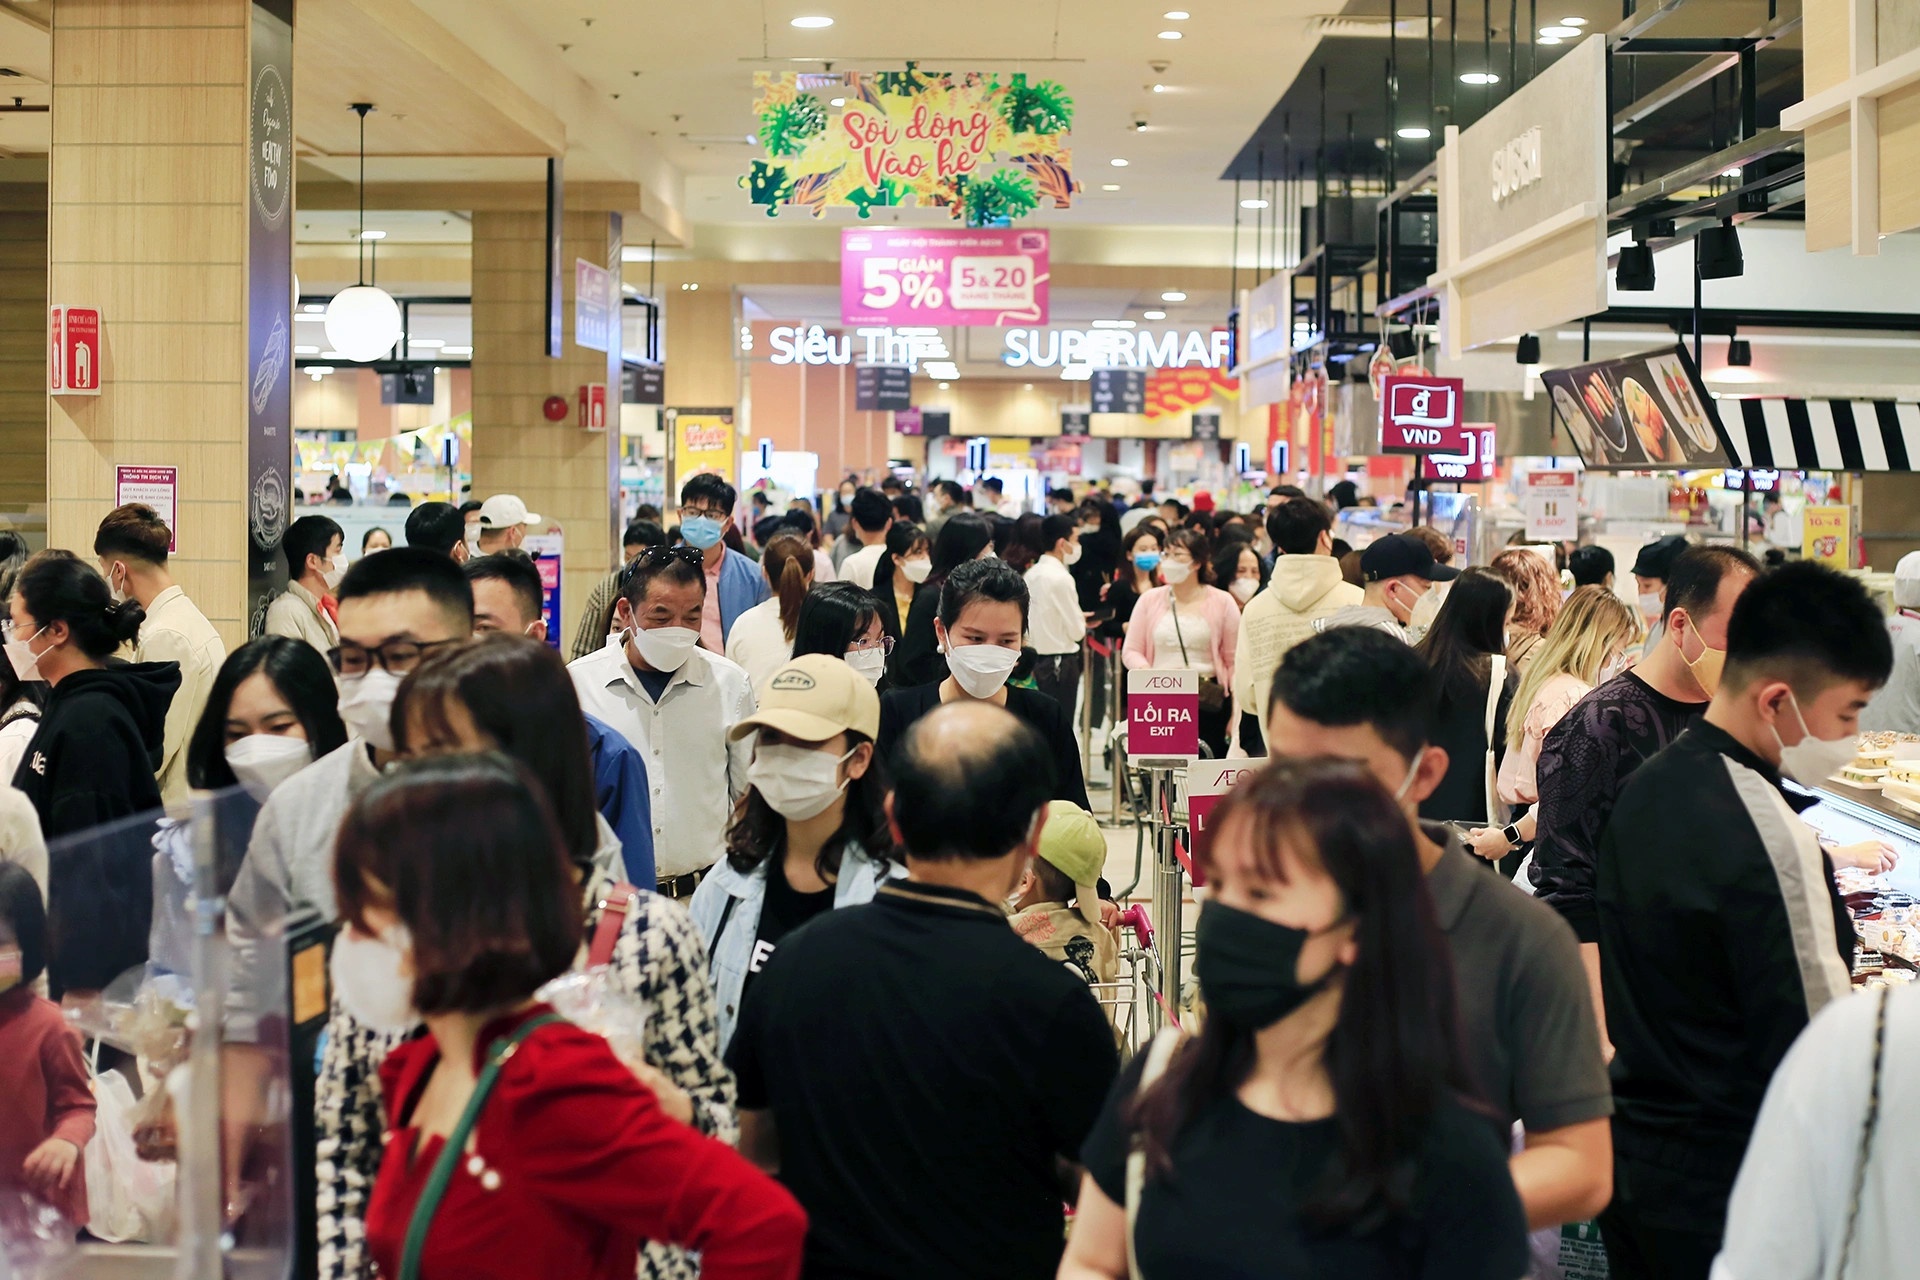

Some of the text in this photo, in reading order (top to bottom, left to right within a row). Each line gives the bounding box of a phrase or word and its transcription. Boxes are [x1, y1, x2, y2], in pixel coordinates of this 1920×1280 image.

[843, 111, 898, 150] Sôi
[262, 140, 283, 167] HEALTHY
[864, 138, 977, 186] Vào hè
[1492, 125, 1542, 202] SUSHI
[264, 165, 279, 190] FOOD
[962, 268, 1026, 288] 5 & 20
[769, 325, 851, 365] Siêu
[1402, 428, 1442, 445] VND
[1436, 463, 1468, 478] VND
[1134, 701, 1192, 723] LỐI RA
[1150, 726, 1175, 737] EXIT
